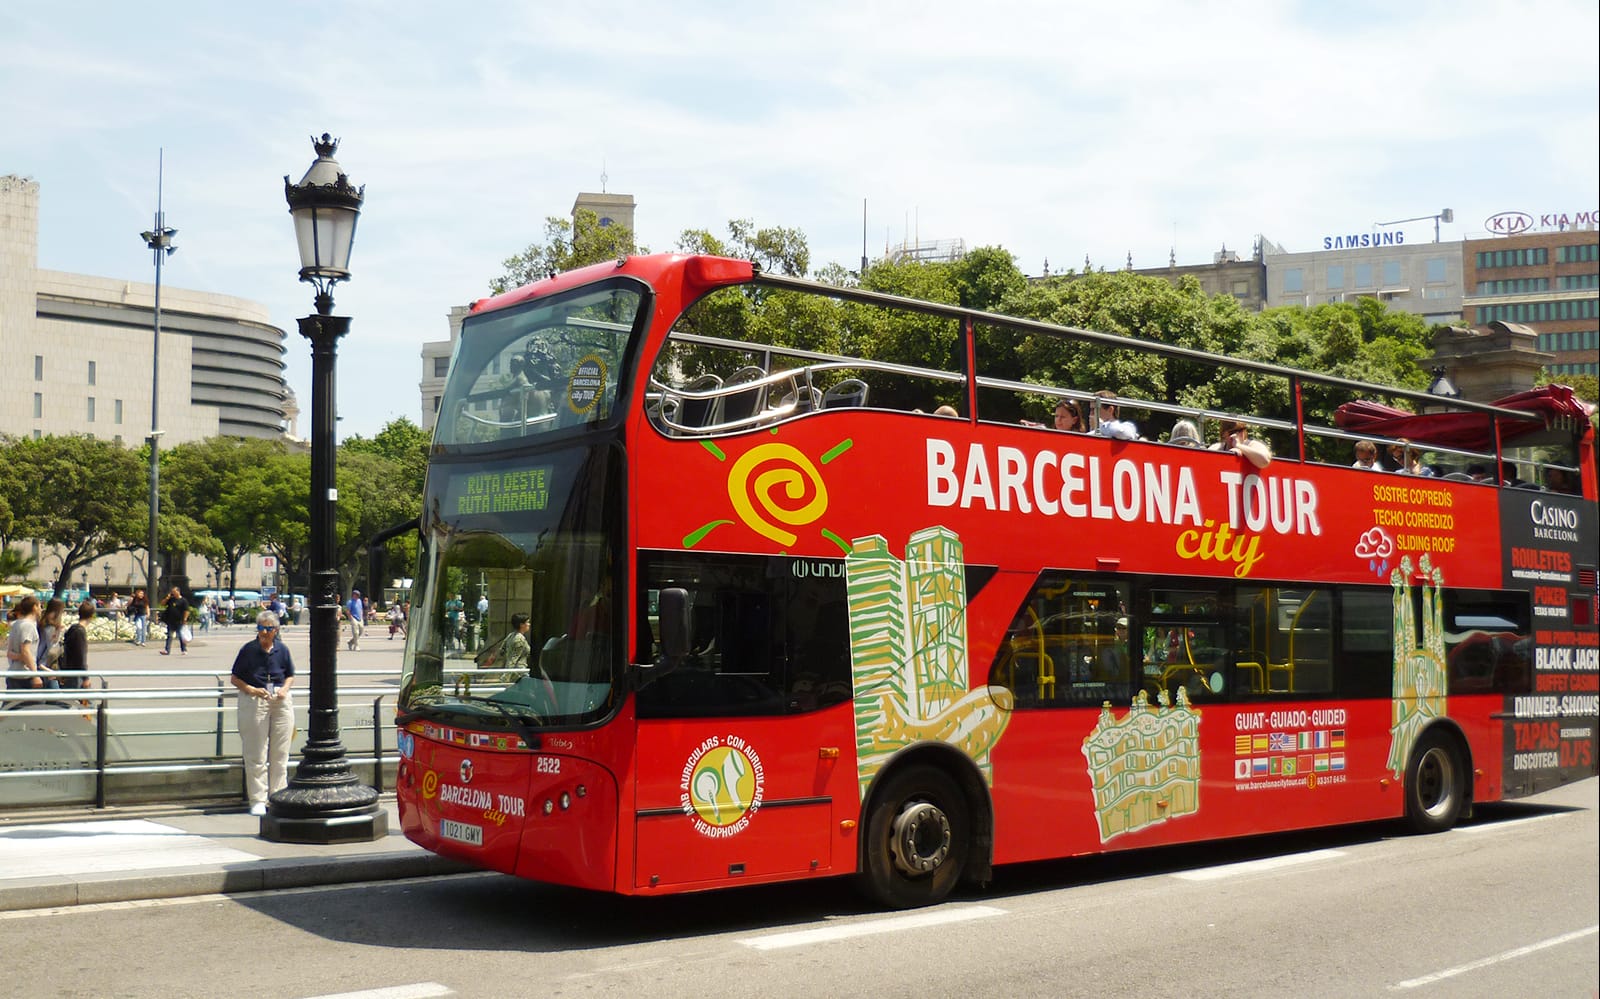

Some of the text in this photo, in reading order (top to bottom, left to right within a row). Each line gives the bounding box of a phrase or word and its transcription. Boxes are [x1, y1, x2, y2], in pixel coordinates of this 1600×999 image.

[1493, 216, 1526, 231] KIA
[1541, 214, 1570, 228] KIA
[1324, 231, 1404, 250] SAMSUNG
[573, 379, 600, 387] BARCELONA
[583, 390, 595, 400] TOUR
[467, 469, 545, 495] RUTA OESTE
[926, 438, 1322, 536] BARCELONA TOUR
[458, 489, 549, 514] RUTA NARANJ
[1373, 485, 1409, 504] SOSTRE
[1373, 509, 1454, 530] TECHO CORREDIZO
[1397, 534, 1455, 552] SLIDING ROOF
[1534, 527, 1578, 542] BARCELONA
[1175, 519, 1264, 579] city
[1512, 547, 1571, 573] ROULETTES
[1535, 586, 1567, 606] POKER
[1535, 648, 1599, 669] BLACK JACK
[1536, 674, 1569, 691] BUFFET
[1235, 709, 1345, 730] GUIAT GUIADO GUIDED
[1514, 721, 1559, 751] TAPAS
[680, 735, 719, 790] AURICULARS
[1514, 751, 1558, 770] DISCOTECA
[1560, 739, 1591, 768] DJ'S
[537, 757, 561, 774] 2522
[726, 735, 765, 813] CON AURICULARES
[440, 784, 526, 817] BARCELONA TOUR
[483, 808, 506, 827] city
[694, 816, 750, 838] HEADPHONES
[445, 822, 462, 839] 1021
